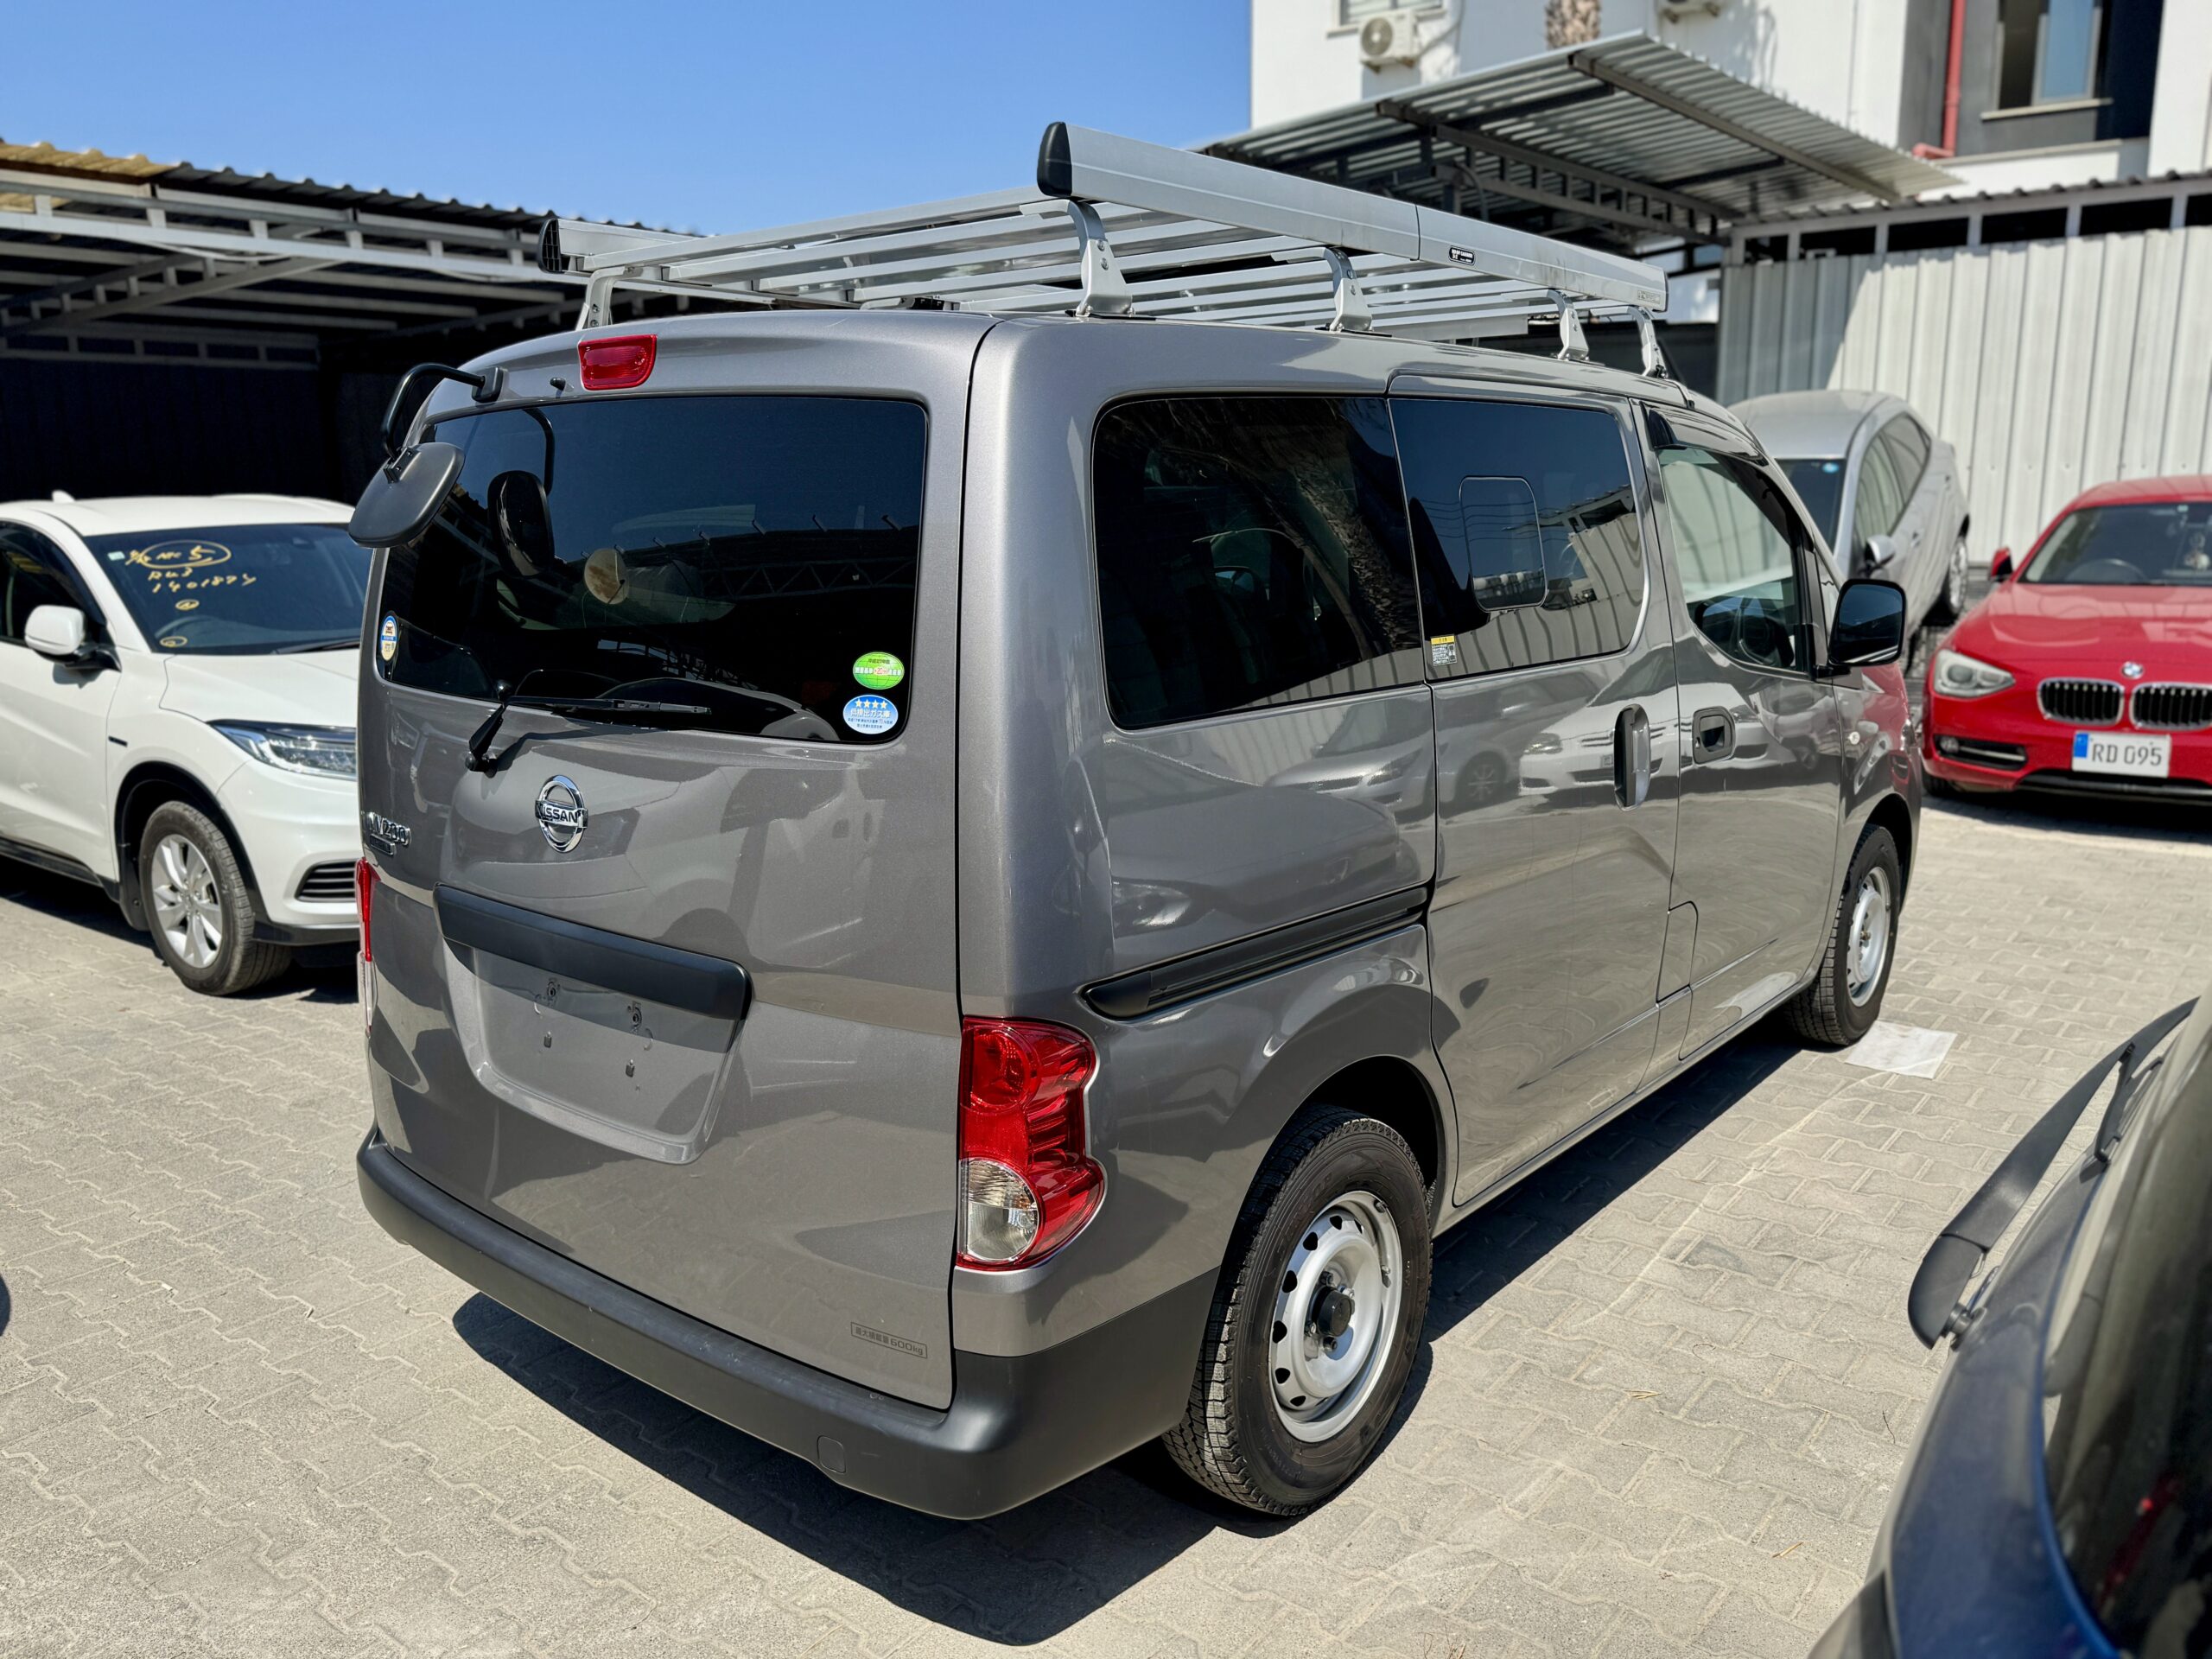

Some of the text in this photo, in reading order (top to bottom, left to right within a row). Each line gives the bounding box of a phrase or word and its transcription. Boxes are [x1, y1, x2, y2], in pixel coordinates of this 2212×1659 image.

[2092, 743, 2162, 766] RD 095
[536, 801, 579, 824] NISSAN
